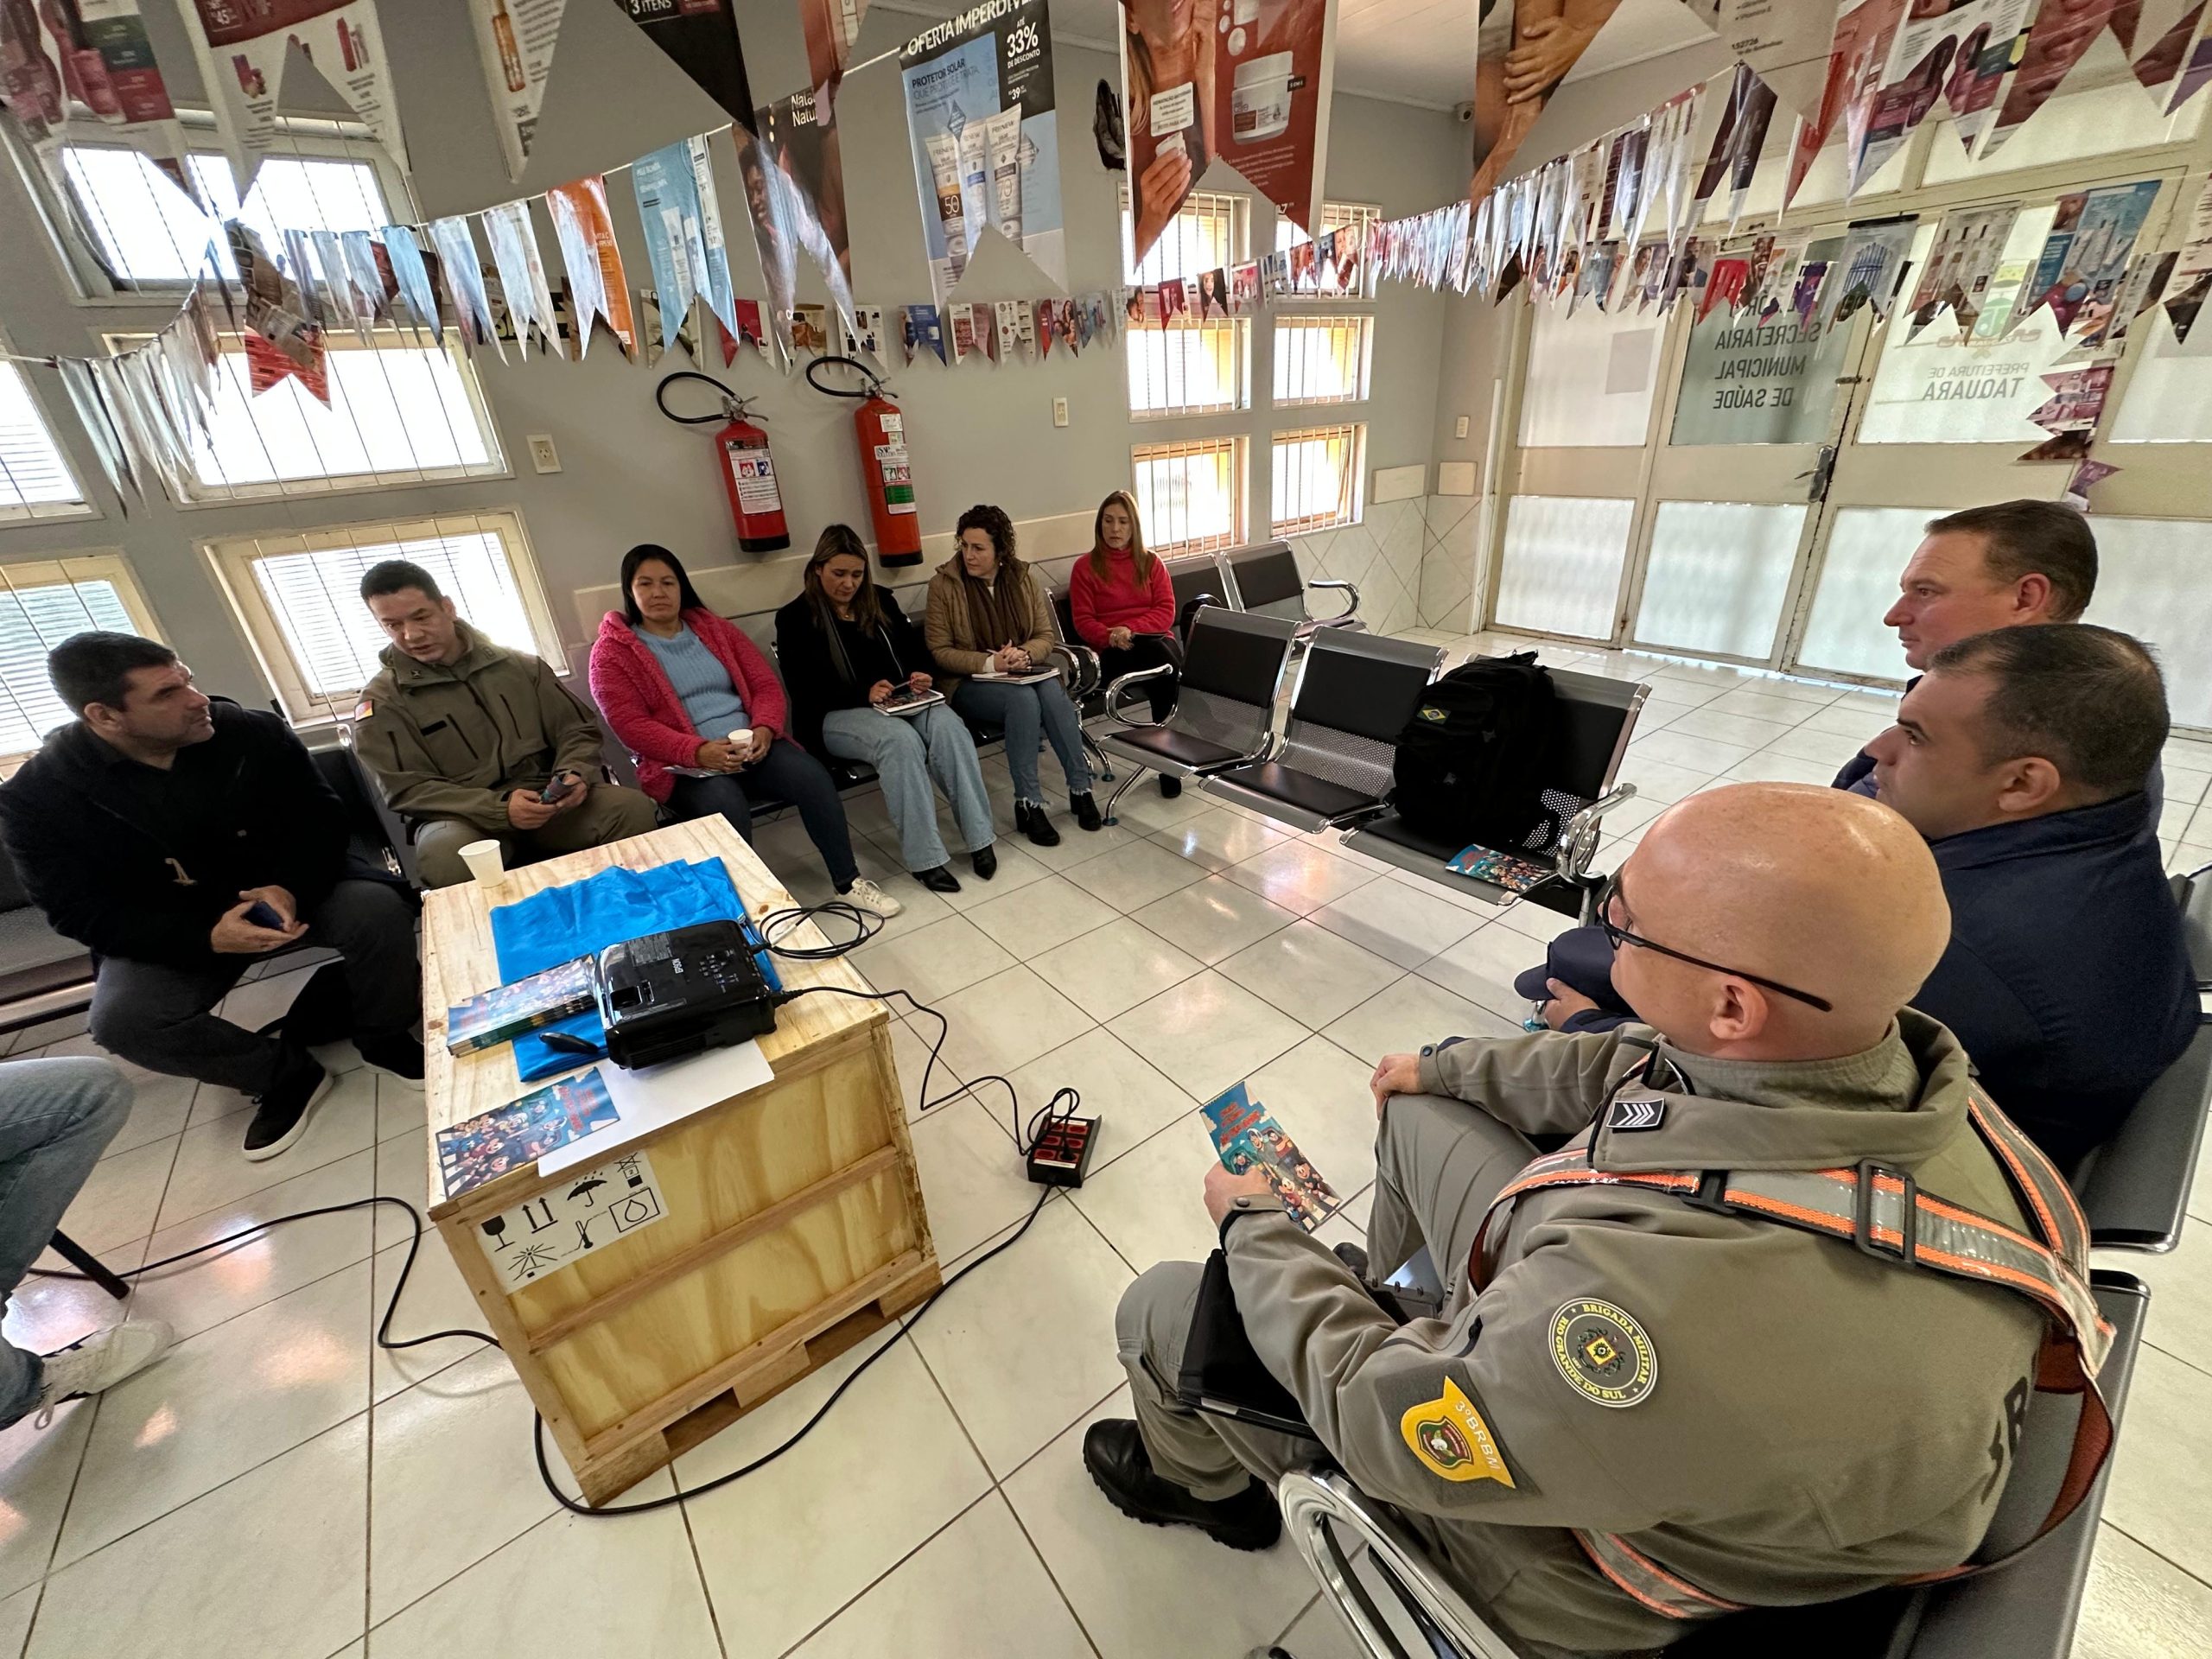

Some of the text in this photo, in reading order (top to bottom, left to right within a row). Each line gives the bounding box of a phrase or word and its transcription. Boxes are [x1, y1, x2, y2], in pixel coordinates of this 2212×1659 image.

[1017, 16, 1026, 29] ATÉ
[907, 23, 955, 56] OFERTA
[1007, 22, 1039, 58] 33%
[1007, 49, 1041, 69] DE DESCONTO
[912, 59, 966, 88] PROTETOR SOLAR
[791, 92, 816, 111] Nata
[792, 108, 817, 127] Natu
[944, 195, 960, 215] 50
[1581, 1303, 1650, 1384] BRIGADA MILITAR
[1554, 1316, 1626, 1400] RIO GRANDE DO SUL
